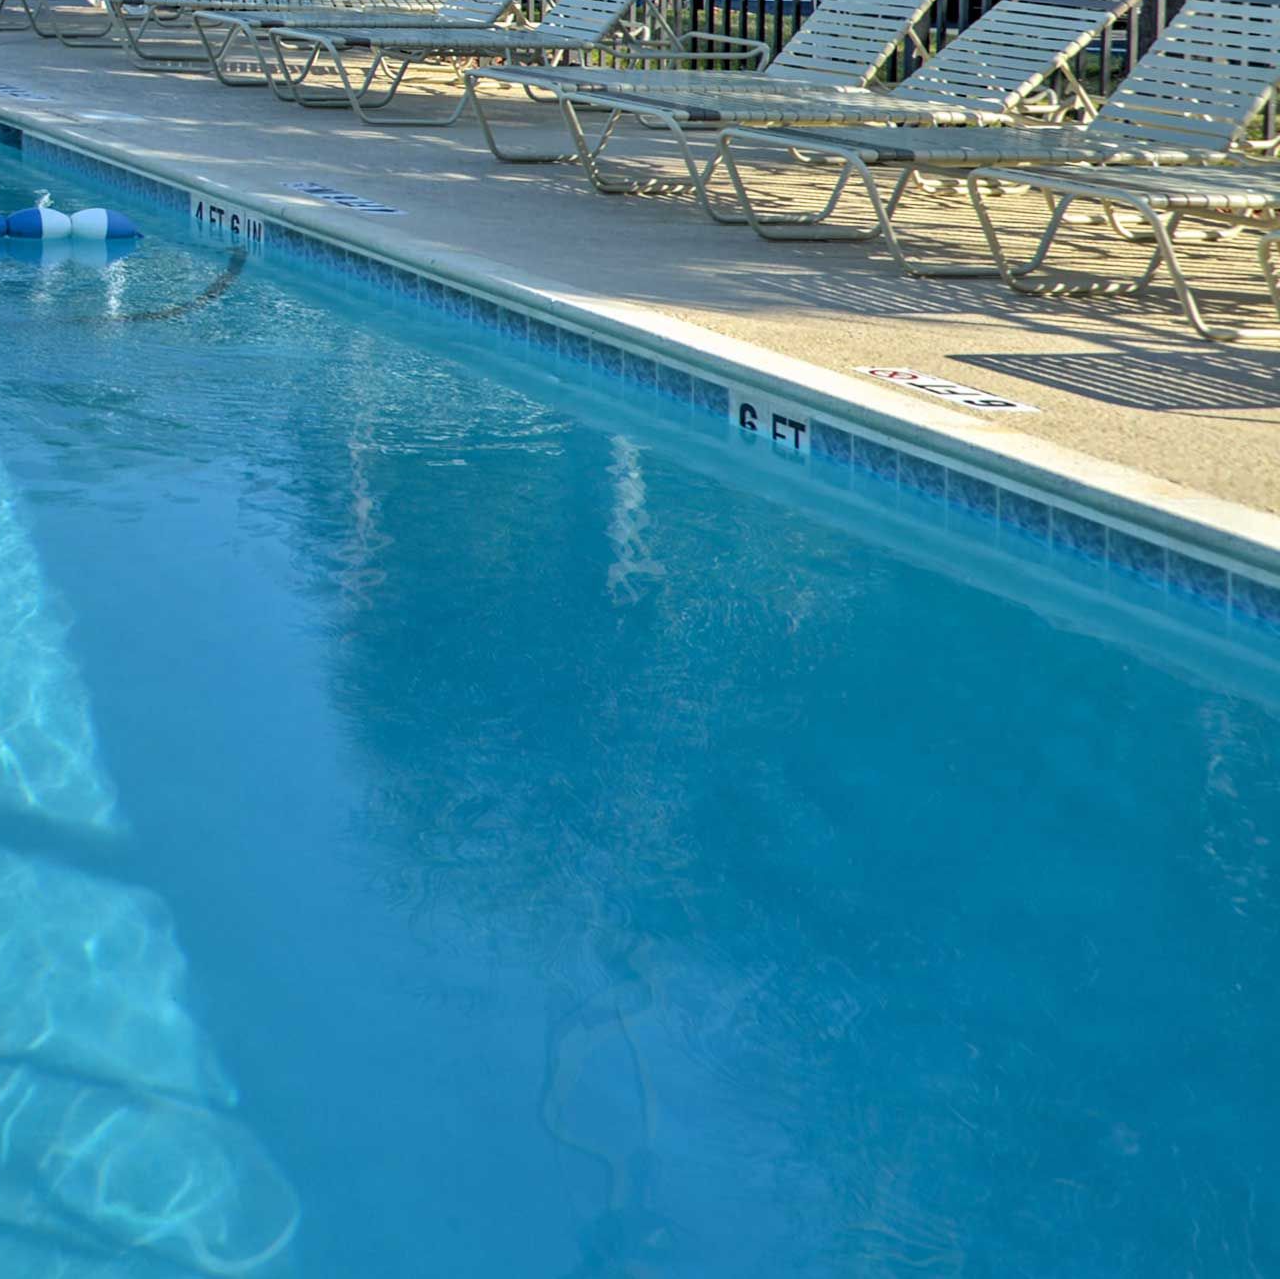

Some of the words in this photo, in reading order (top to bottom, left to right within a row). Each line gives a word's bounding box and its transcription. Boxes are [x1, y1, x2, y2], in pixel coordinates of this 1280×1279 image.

[195, 201, 203, 221] 4
[209, 205, 225, 229] FT
[247, 218, 262, 242] IN
[907, 382, 981, 396] FT
[964, 399, 1017, 408] 6
[739, 403, 758, 432] 6
[771, 413, 807, 450] FT
